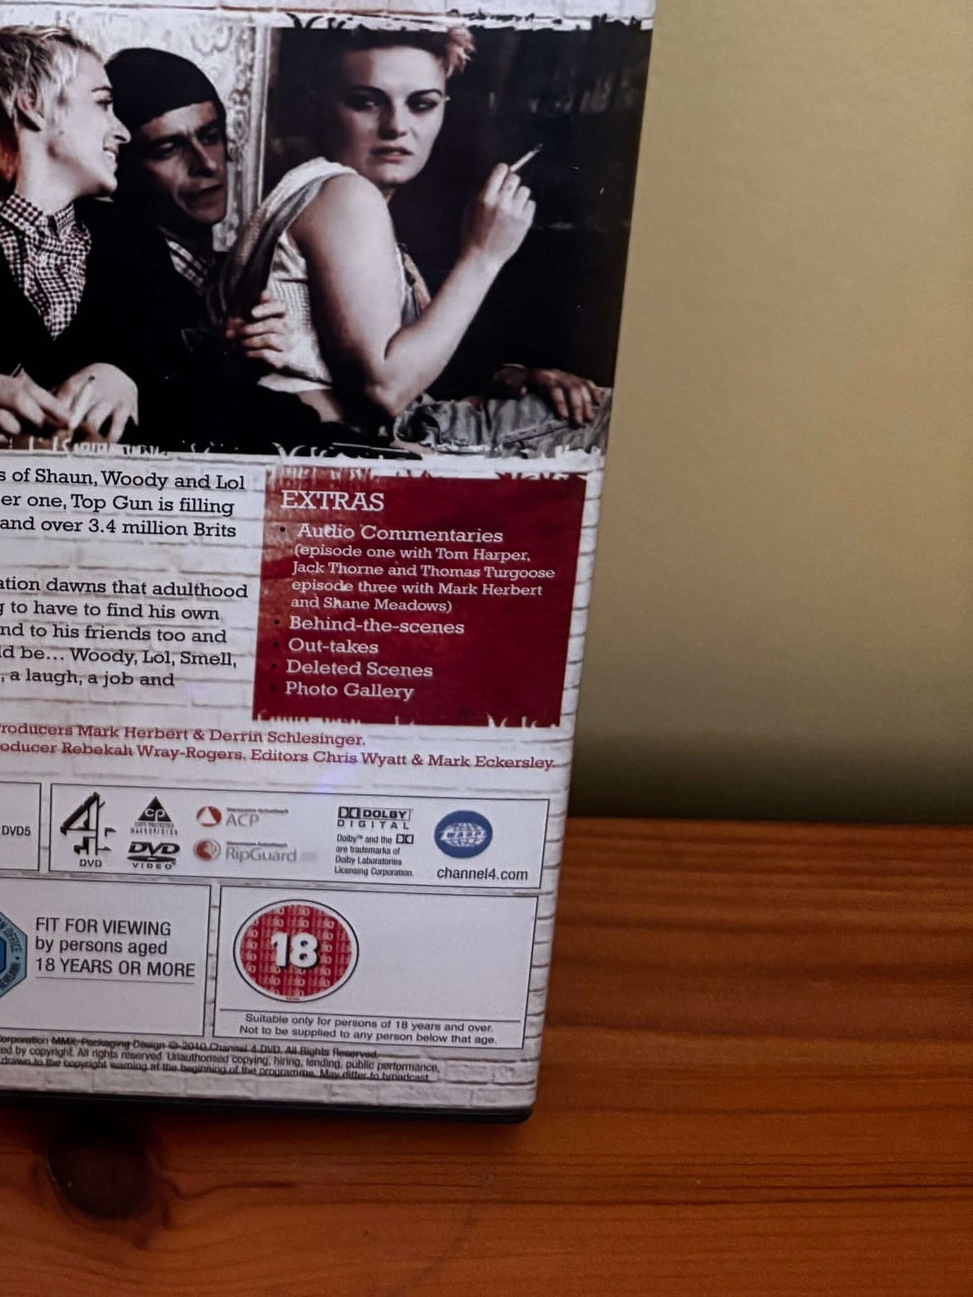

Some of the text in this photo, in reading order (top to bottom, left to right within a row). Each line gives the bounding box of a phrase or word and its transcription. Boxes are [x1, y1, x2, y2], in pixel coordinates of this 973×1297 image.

[12, 469, 31, 482] of
[35, 469, 98, 486] Shaun,
[101, 471, 169, 490] Woody
[174, 474, 211, 488] and
[216, 475, 245, 490] Lol
[280, 489, 384, 512] EXTRAS
[297, 524, 503, 543] Audio Commentaries
[295, 544, 530, 563] (episode one with Tom Harper,
[292, 562, 555, 581] Jack Thorne and Thomas Turgoose
[292, 580, 543, 596] episode three with Mark Herbert
[291, 597, 452, 613] and Shane Meadows)
[289, 616, 465, 634] Behind-the-scenes
[289, 638, 379, 653] Out-takes
[286, 660, 433, 677] Deleted Scenes
[285, 682, 414, 701] Photo Gallery
[226, 814, 259, 827] ACP
[363, 809, 407, 819] DOLBY
[337, 821, 409, 830] DIGITAL
[129, 842, 180, 854] DVD
[226, 846, 297, 863] RipGuard
[80, 859, 102, 868] DVD
[133, 862, 172, 870] VIDEO
[437, 867, 528, 881] channel4.com
[36, 917, 171, 936] FIT FOR VIEWING
[35, 936, 167, 956] by persons aged
[271, 932, 319, 970] 18
[37, 958, 195, 977] 18 YEARS OR MORE
[245, 1013, 493, 1033] Suitable only for persons of 18 years and over.
[240, 1025, 496, 1046] Not to be supplied to any person below that age.
